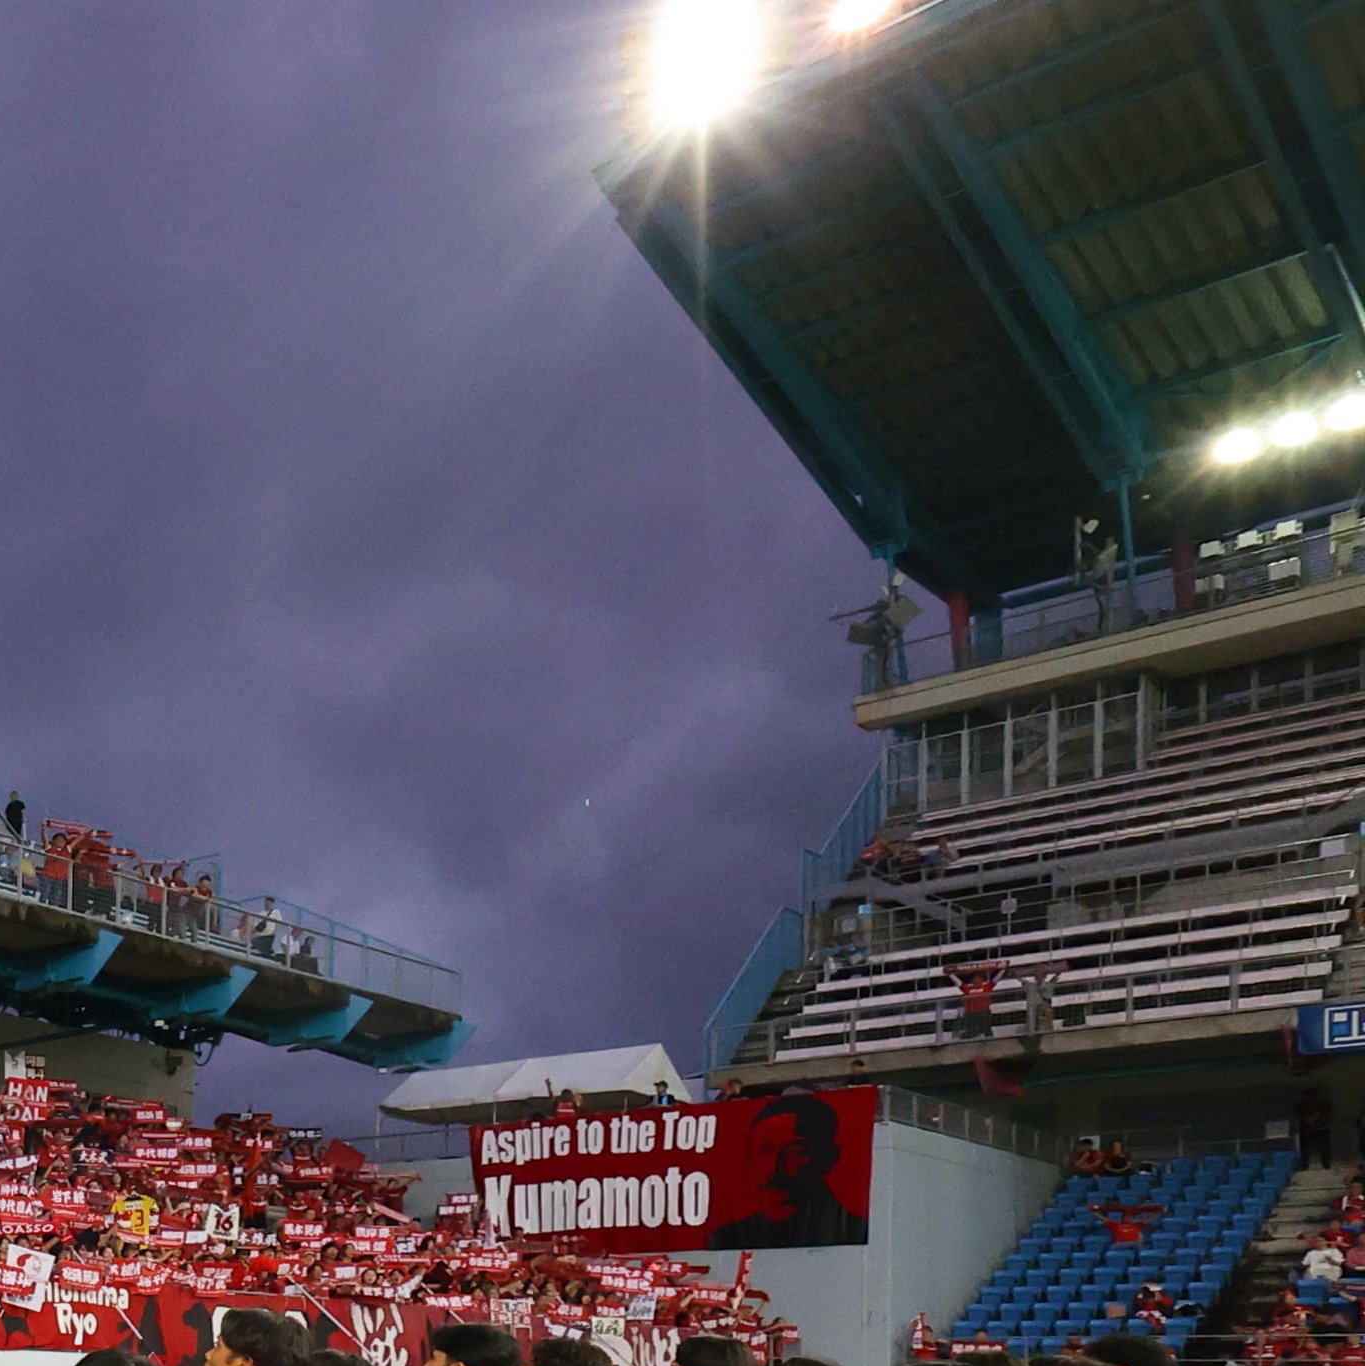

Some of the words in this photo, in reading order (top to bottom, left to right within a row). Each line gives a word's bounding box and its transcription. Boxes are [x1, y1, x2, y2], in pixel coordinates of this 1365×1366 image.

[7, 1081, 49, 1102] HAN
[480, 1122, 570, 1166] Aspire
[576, 1117, 606, 1155] to
[609, 1113, 655, 1154] the
[660, 1109, 717, 1154] Top
[213, 1213, 234, 1232] 16
[483, 1166, 711, 1238] Kumamoto
[54, 1302, 98, 1346] Ryo
